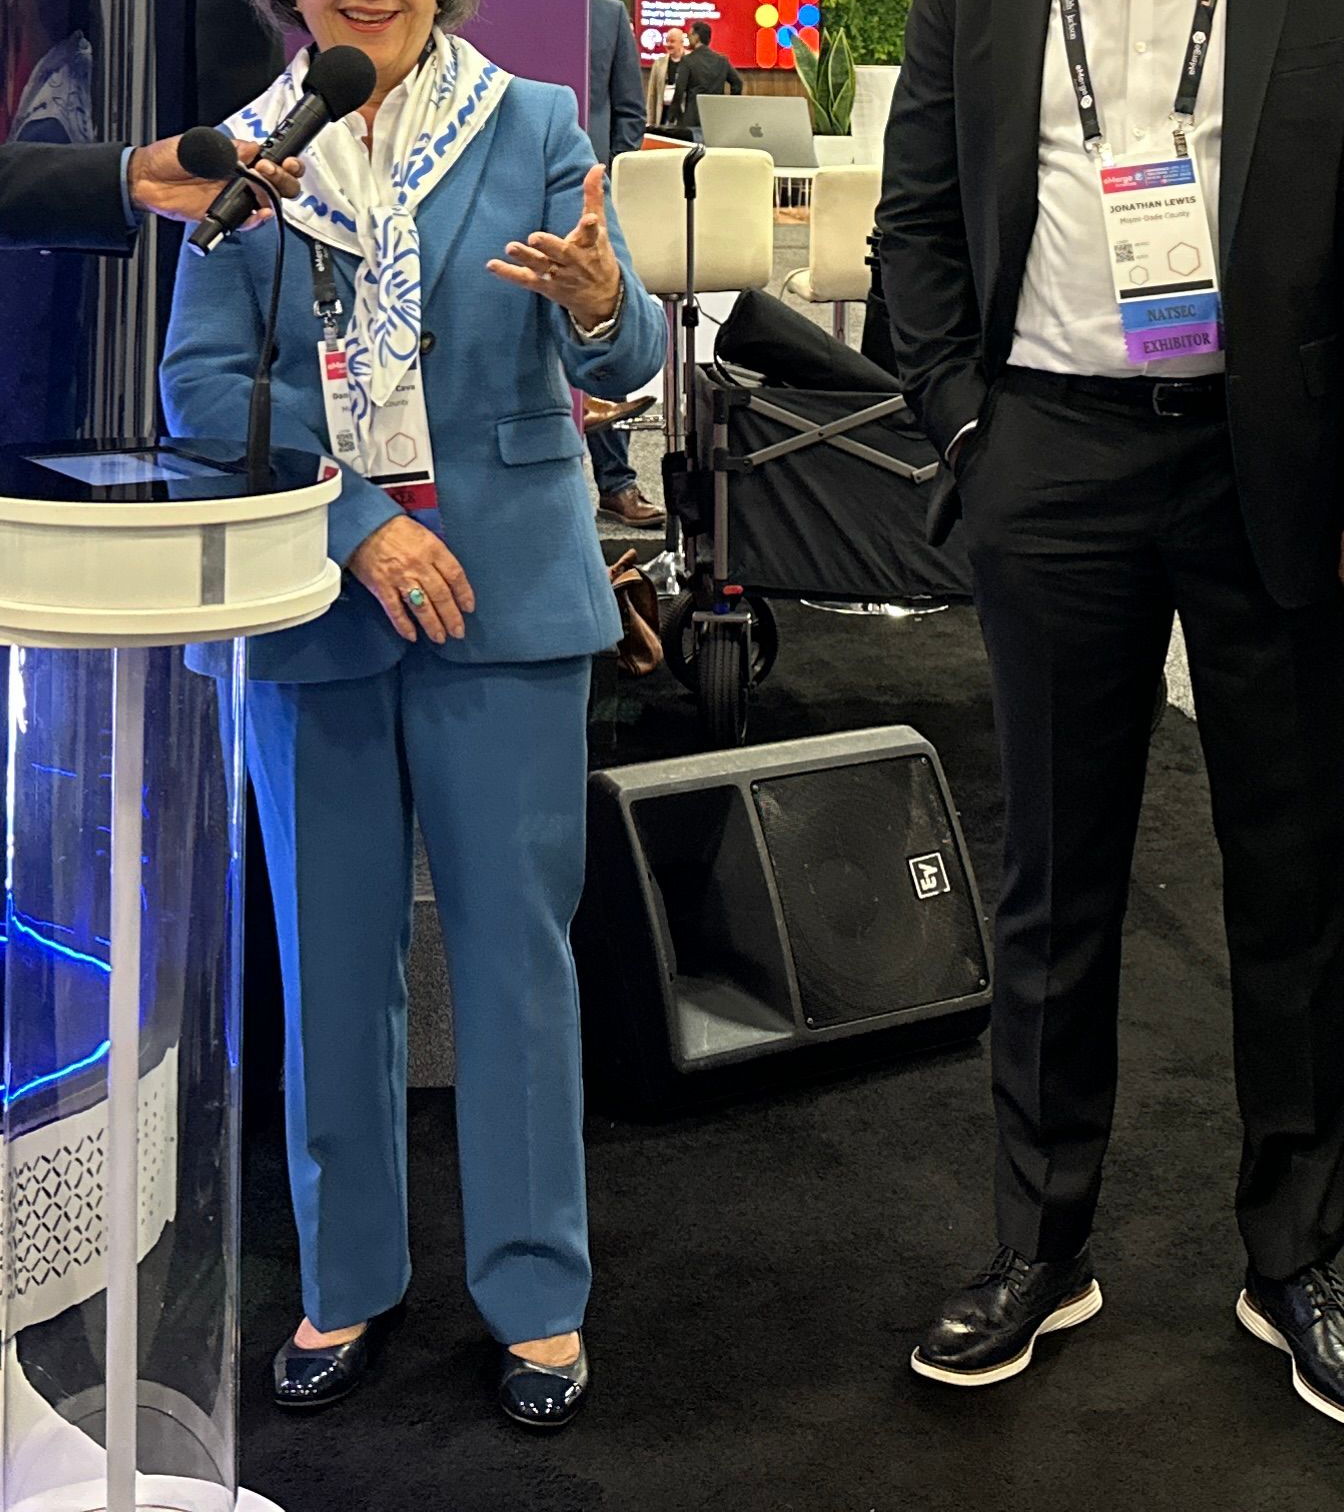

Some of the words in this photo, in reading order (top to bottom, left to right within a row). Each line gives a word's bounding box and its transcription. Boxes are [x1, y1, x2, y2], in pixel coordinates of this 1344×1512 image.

[1110, 200, 1162, 213] JONATHAN
[1164, 196, 1196, 207] LEWIS
[314, 241, 325, 272] eMerg
[1147, 304, 1197, 323] NATSEC
[1143, 332, 1211, 355] EXHIBITOR
